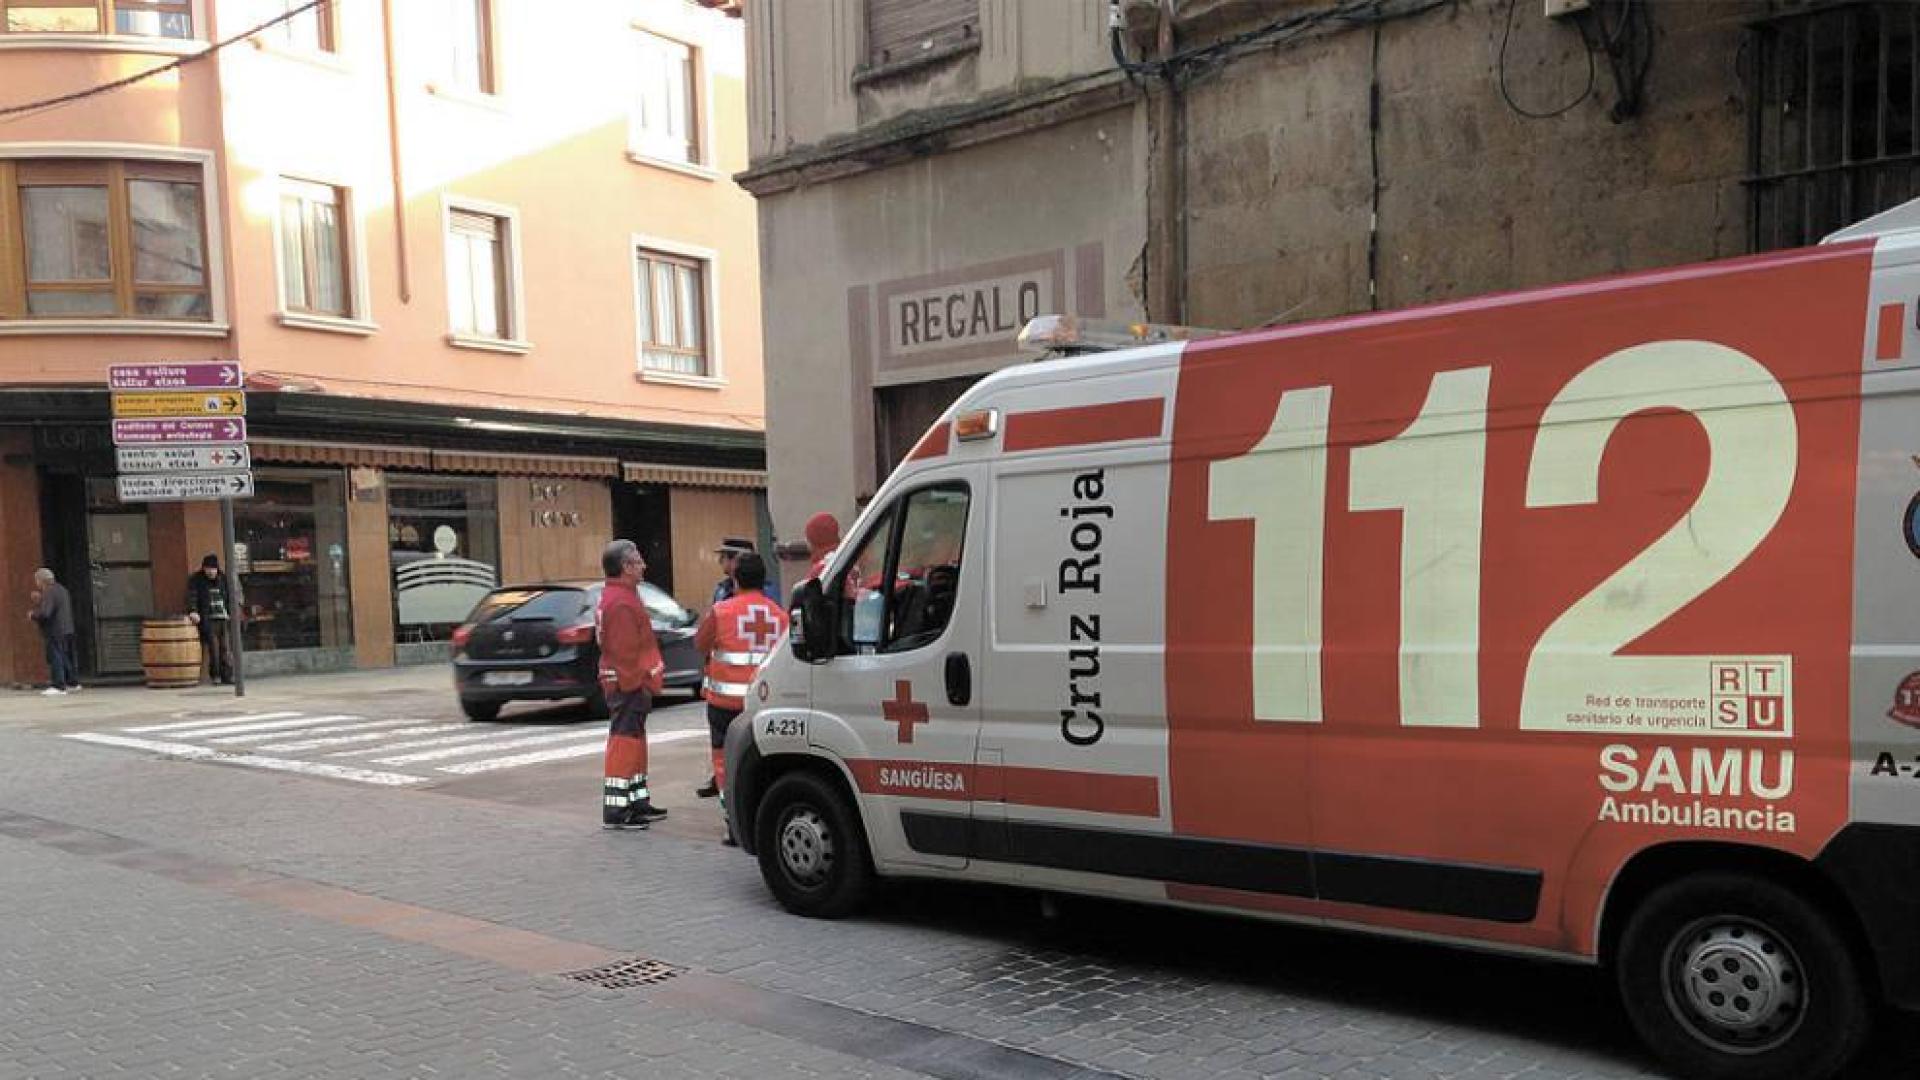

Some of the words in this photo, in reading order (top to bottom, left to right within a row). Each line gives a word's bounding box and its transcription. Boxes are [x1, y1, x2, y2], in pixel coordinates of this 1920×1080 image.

[901, 280, 1040, 346] REGALO
[1058, 466, 1113, 594] Roja
[1207, 339, 1799, 736] 112
[1060, 614, 1104, 746] Cruz
[1585, 695, 1611, 708] Red
[1615, 696, 1632, 708] de
[1635, 696, 1706, 711] transporte
[765, 719, 807, 736] A-231
[1626, 713, 1643, 727] de
[1647, 715, 1706, 729] urgencia
[879, 766, 966, 792] SANGÜESA
[1598, 743, 1795, 801] SAMU
[1597, 796, 1796, 833] Ambulancia
